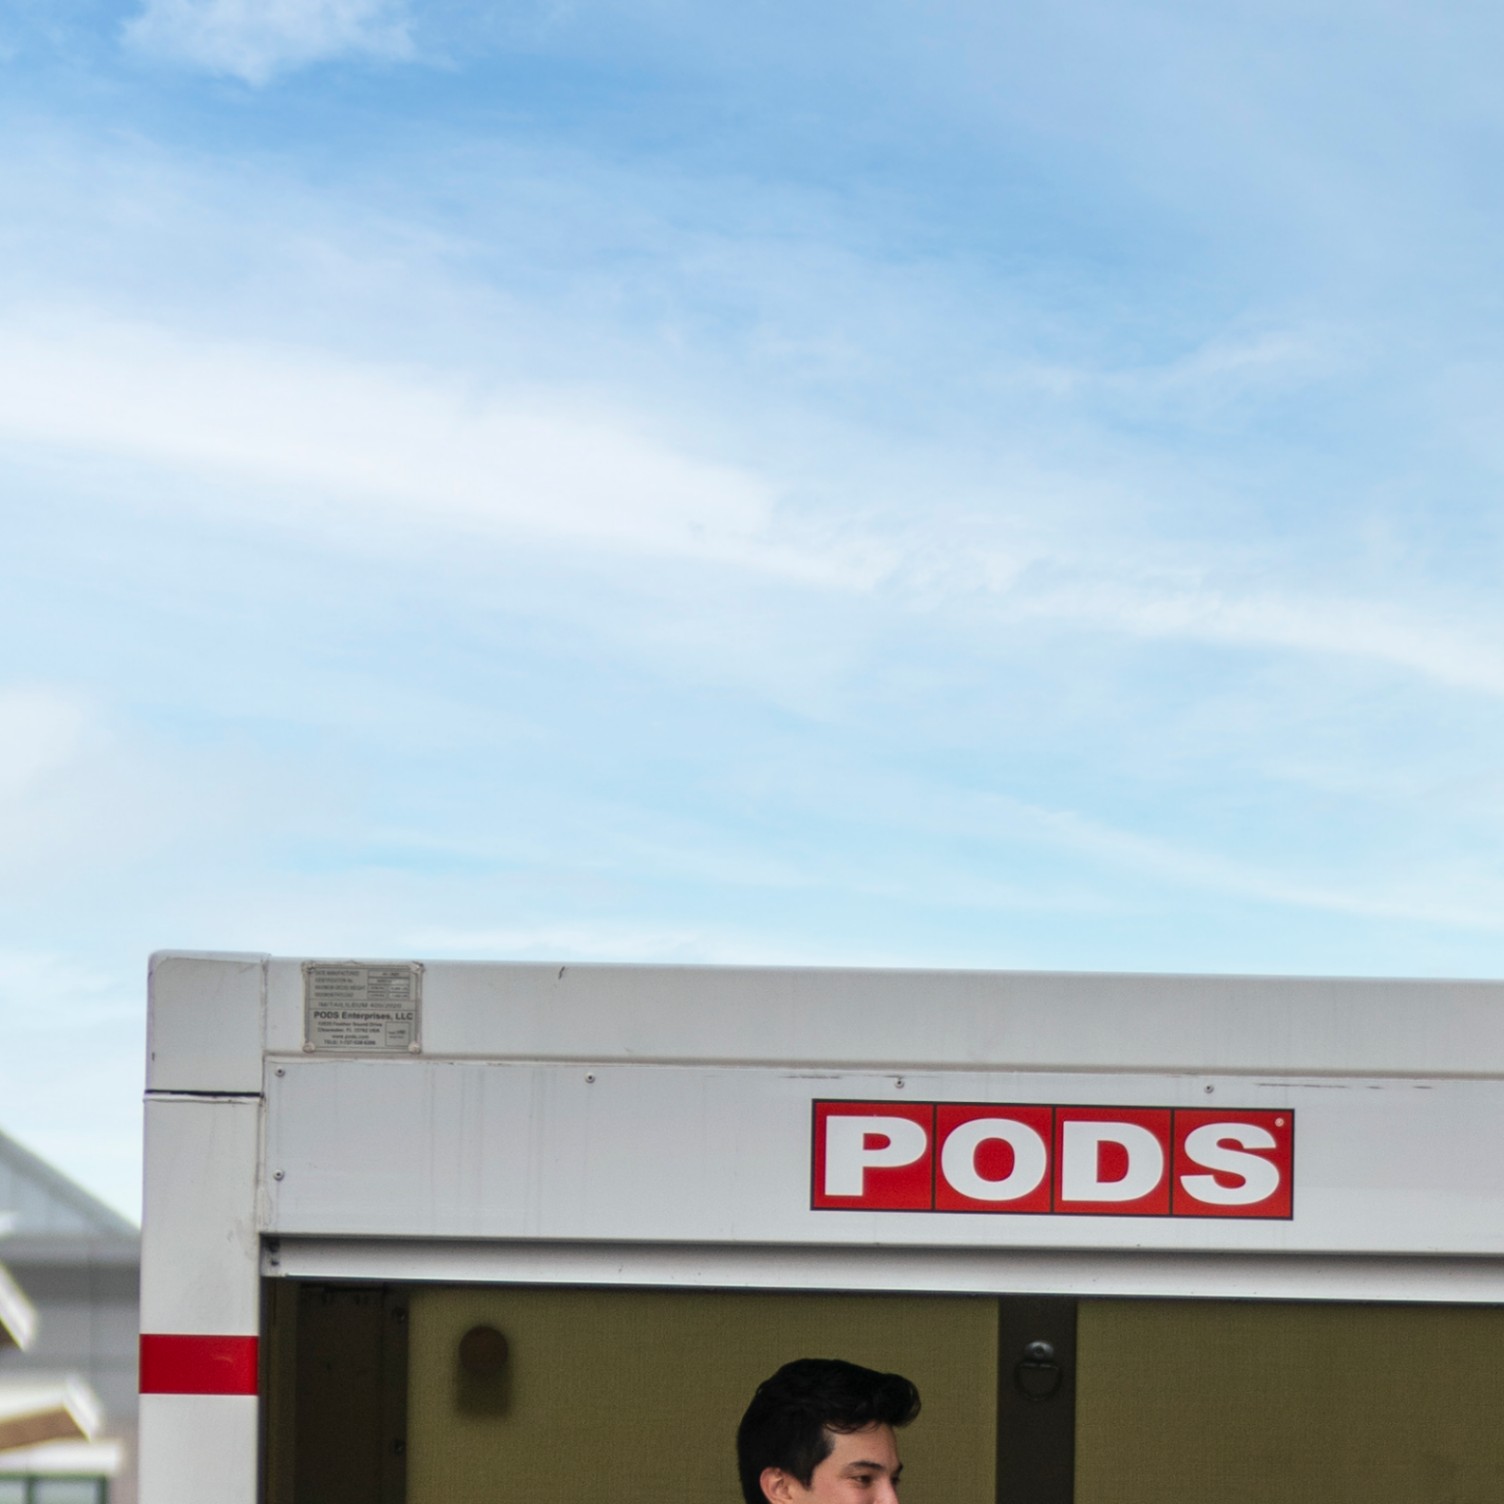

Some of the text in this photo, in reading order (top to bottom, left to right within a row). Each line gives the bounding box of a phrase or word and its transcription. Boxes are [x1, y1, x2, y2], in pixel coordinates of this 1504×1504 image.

[313, 1011, 339, 1020] PODS
[395, 1012, 414, 1021] LLC
[824, 1114, 1281, 1206] PODS
